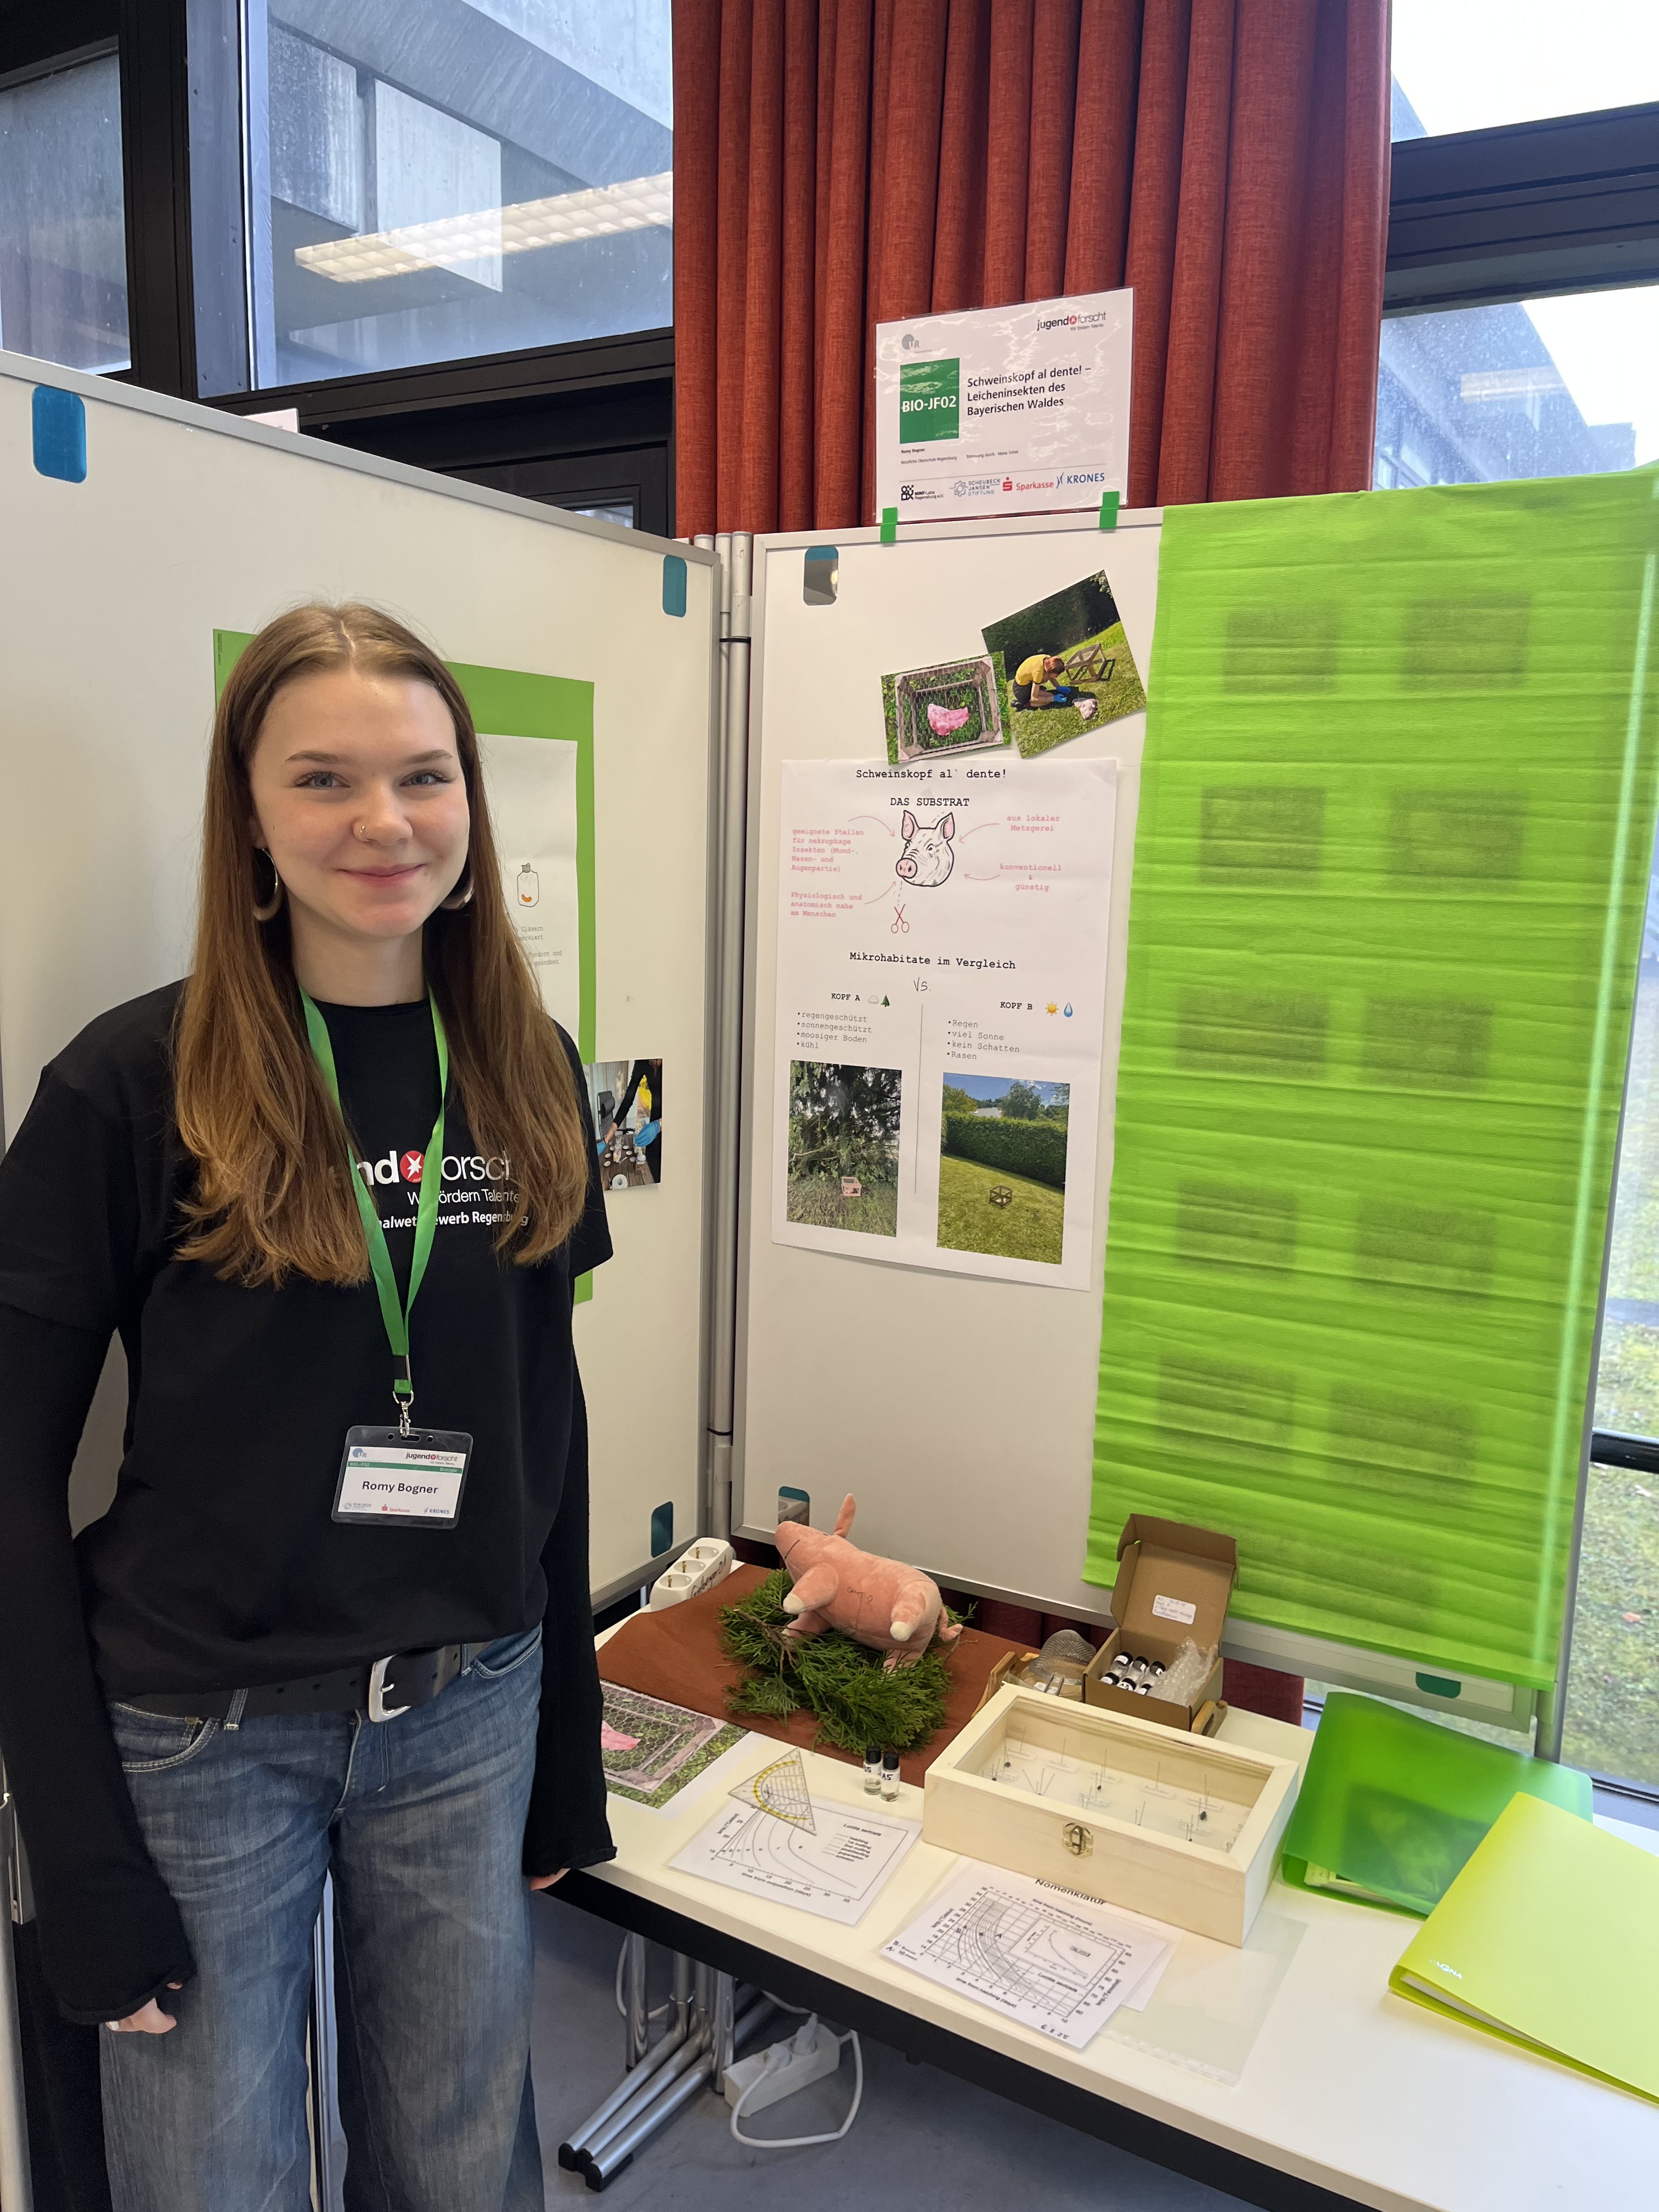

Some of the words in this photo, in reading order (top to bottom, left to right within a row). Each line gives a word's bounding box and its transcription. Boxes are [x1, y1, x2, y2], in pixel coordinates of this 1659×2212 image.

[1037, 316, 1069, 331] jugend
[1077, 311, 1106, 324] forscht
[967, 370, 1035, 387] Schweinskopf
[1038, 369, 1047, 379] al
[1050, 365, 1082, 378] dente!
[967, 385, 1045, 402] Leicheninsekten
[1048, 382, 1065, 392] des
[902, 395, 957, 413] BIO-JF02
[967, 402, 1024, 417] Bayerischen
[1028, 397, 1064, 409] Waldes
[1067, 473, 1105, 484] KRONES
[1016, 481, 1054, 492] Sparkasse
[856, 769, 933, 780] Schweinskopf
[966, 769, 1006, 778] dente!
[890, 798, 910, 806] DAS
[916, 798, 969, 806] SUBSTRAT
[1010, 825, 1054, 833] Metzgerei
[791, 864, 840, 872] Augenpartie)
[1015, 883, 1049, 892] günstig
[791, 892, 845, 900] Physiologisch
[849, 952, 931, 964] Mikrohabitate
[937, 957, 950, 966] im
[956, 958, 1016, 970] Vergleich
[801, 1012, 867, 1023] regengeschützt
[801, 1022, 873, 1033] sonnengeschützt
[952, 1019, 978, 1029] Regen
[800, 1031, 838, 1041] moosiger
[843, 1035, 867, 1043] Boden
[952, 1030, 972, 1039] viel
[978, 1032, 1005, 1041] Sonne
[800, 1041, 819, 1049] kühl
[952, 1040, 972, 1049] kein
[978, 1042, 1020, 1053] Schatten
[951, 1051, 977, 1060] Rasen
[438, 1189, 481, 1205] ördern
[437, 1454, 458, 1462] forscht
[362, 1481, 395, 1493] Romy
[398, 1482, 438, 1495] Bogner
[882, 1773, 894, 1781] A5
[1035, 1878, 1107, 1905] Nomenklatur
